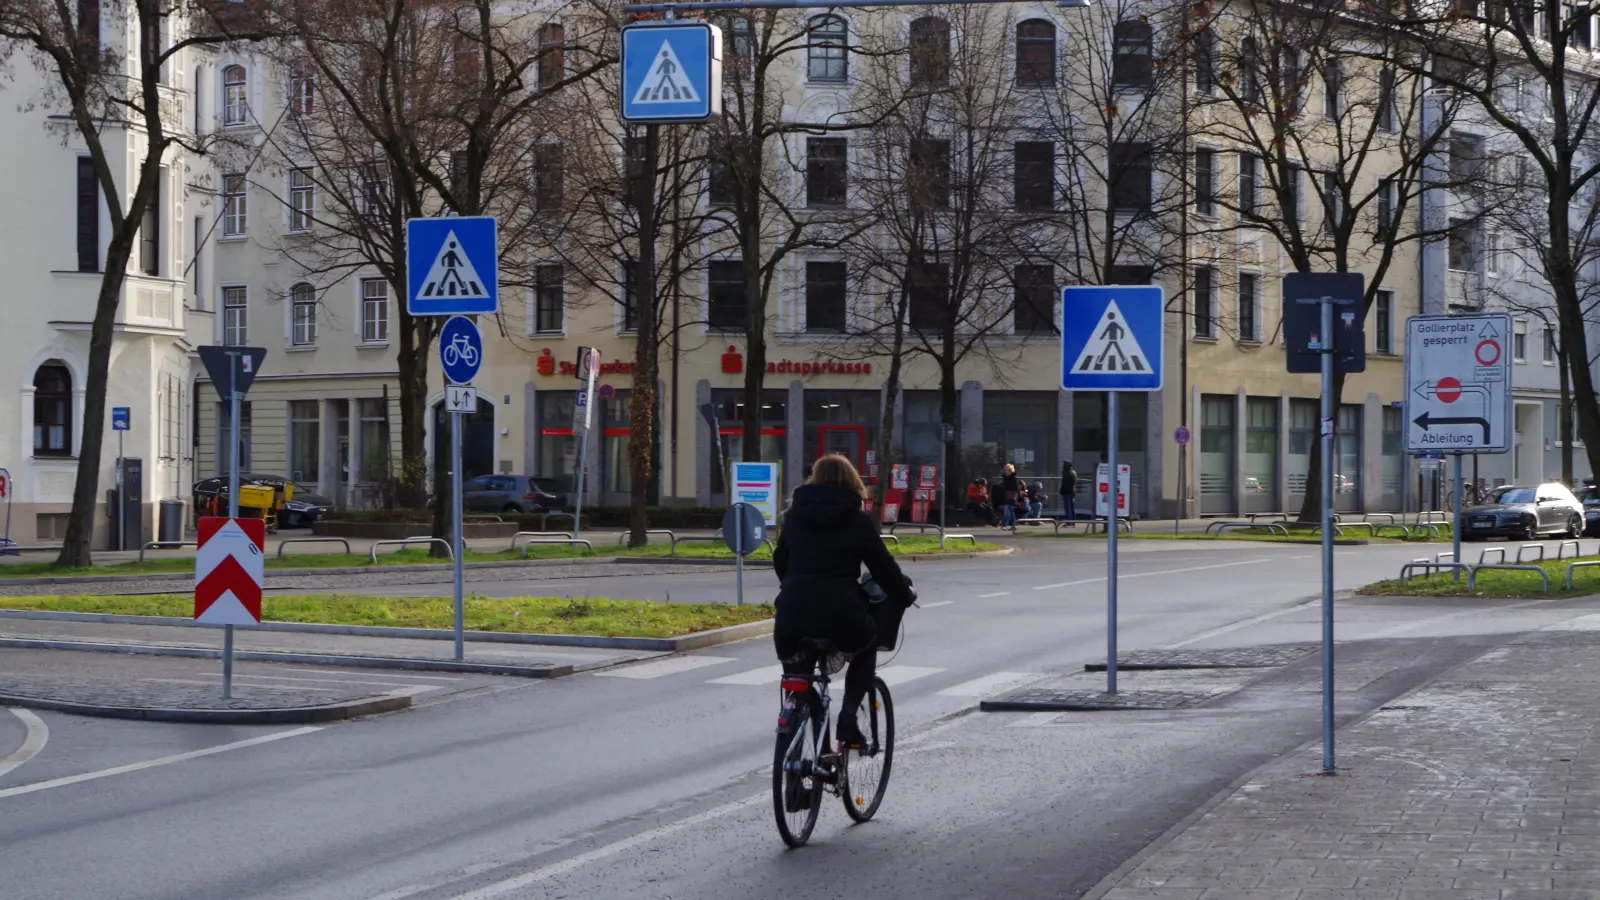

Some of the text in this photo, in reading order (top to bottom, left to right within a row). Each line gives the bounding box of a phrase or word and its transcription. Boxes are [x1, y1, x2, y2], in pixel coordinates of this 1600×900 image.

[1417, 322, 1475, 333] Gollierplatz
[1423, 336, 1468, 347] gesperrt
[766, 359, 872, 376] adtsparkasse
[1420, 432, 1473, 445] Ableitung
